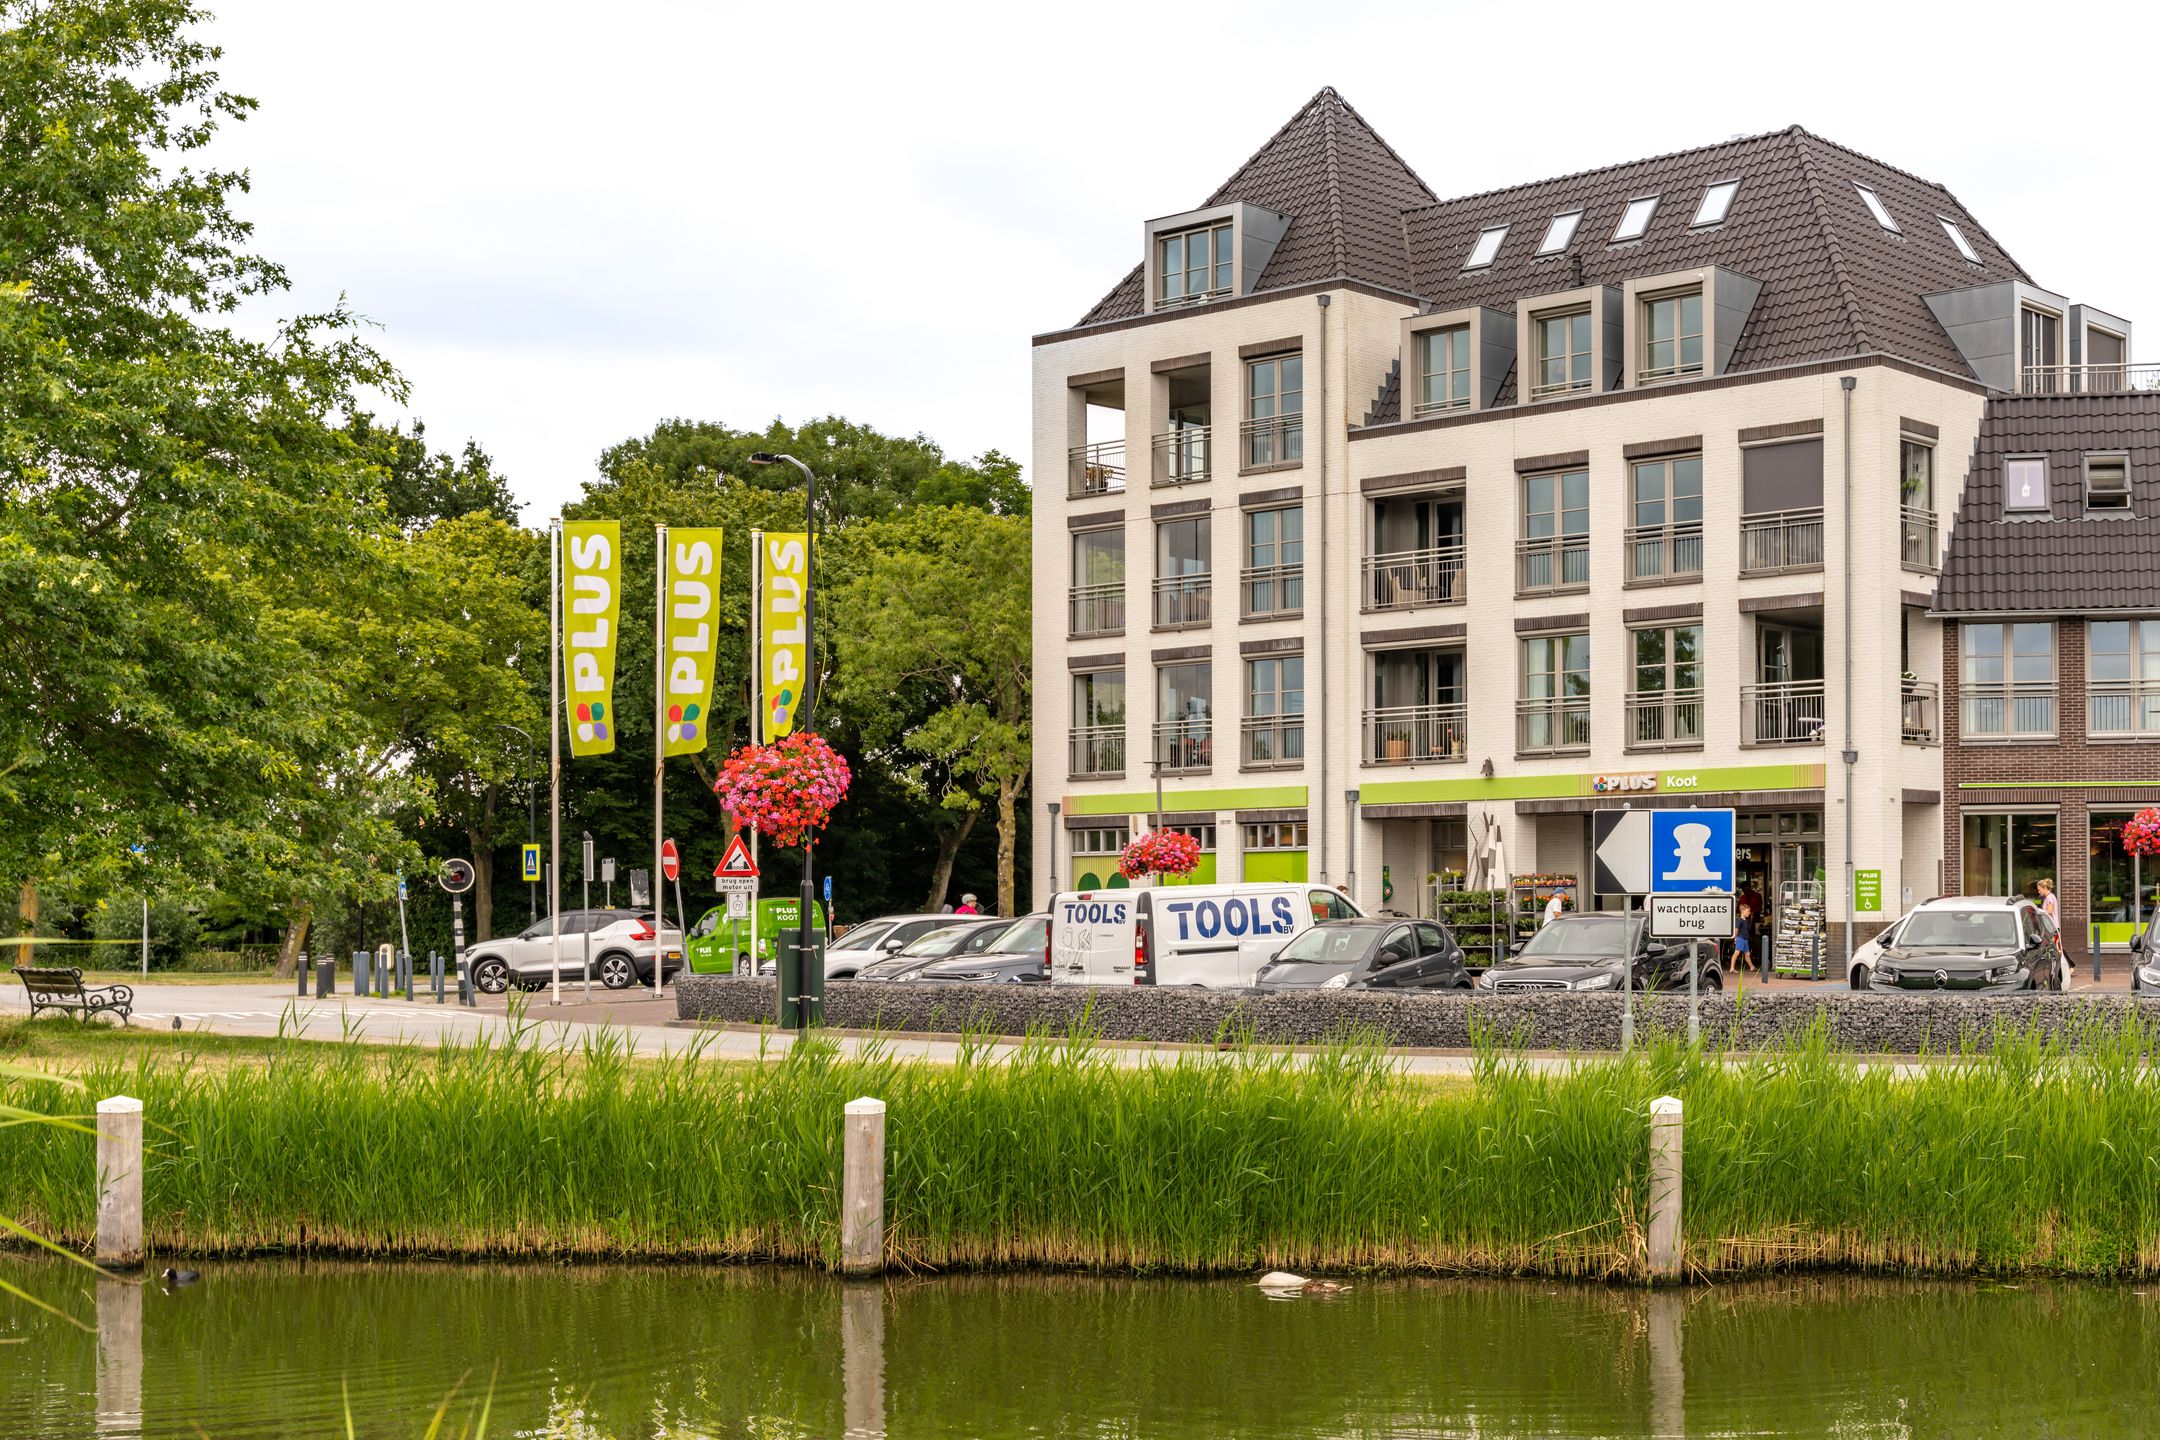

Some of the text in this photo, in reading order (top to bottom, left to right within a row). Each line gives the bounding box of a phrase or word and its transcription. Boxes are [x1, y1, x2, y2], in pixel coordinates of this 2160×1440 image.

[571, 534, 611, 692] PLUS
[669, 541, 713, 694] PLUS
[770, 540, 805, 686] PLUS
[1607, 775, 1698, 791] PLUS Koot
[1064, 903, 1126, 924] TOOLS
[1166, 896, 1294, 940] TOOLS BV
[1657, 903, 1728, 915] wachtplaats
[1679, 918, 1705, 930] brug
[700, 946, 712, 954] PLUS
